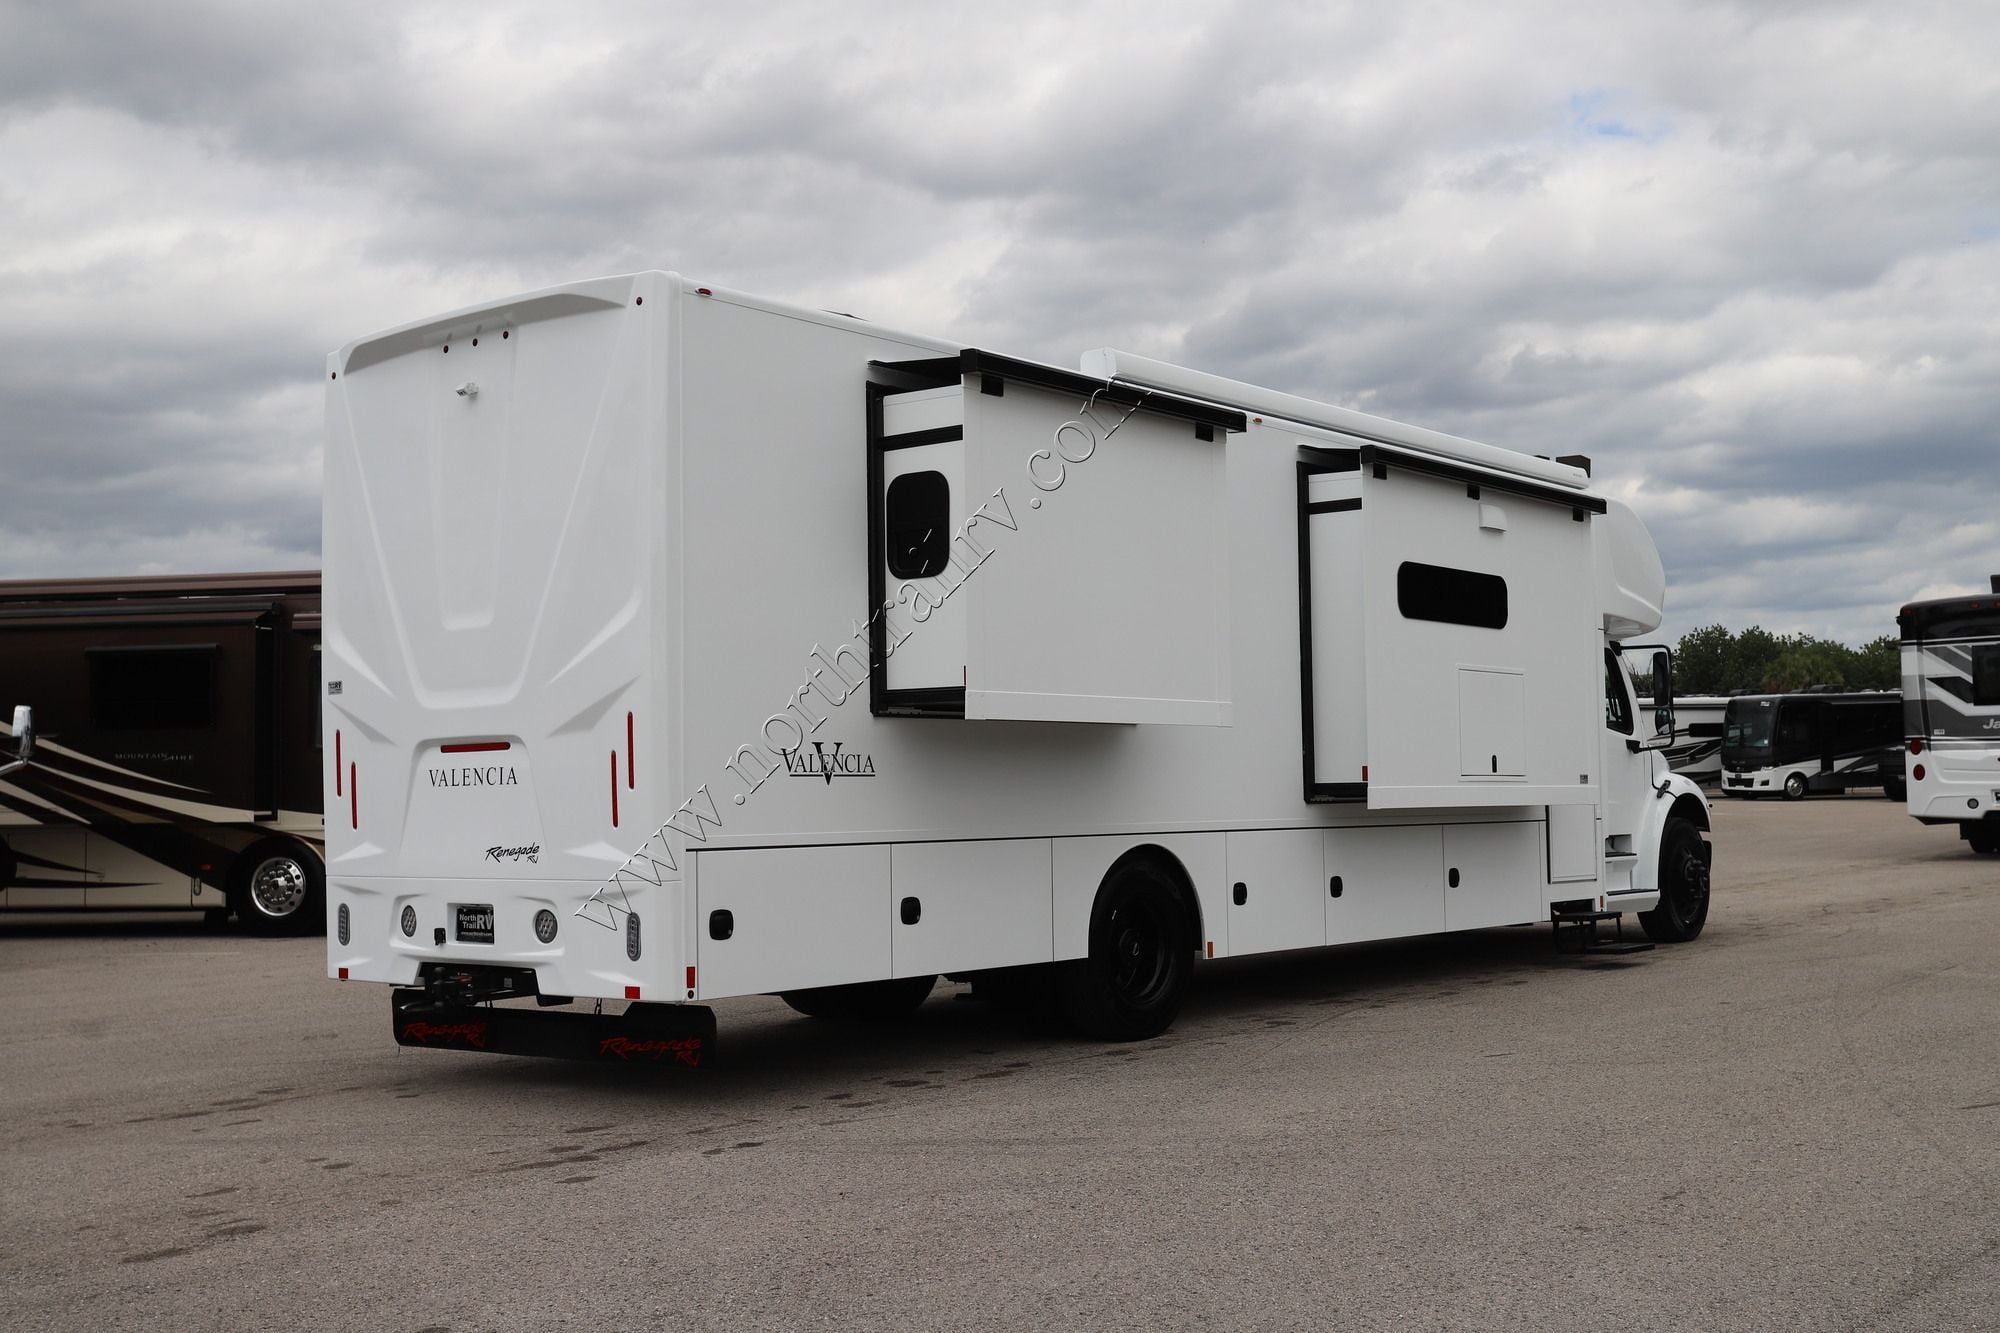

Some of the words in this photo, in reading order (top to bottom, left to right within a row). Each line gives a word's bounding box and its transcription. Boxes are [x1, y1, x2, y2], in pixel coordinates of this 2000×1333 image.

[780, 743, 875, 780] VALENCIA
[428, 766, 518, 787] VALENCIA
[485, 841, 540, 863] Renegade
[459, 913, 477, 921] North
[476, 914, 494, 930] RV
[462, 921, 477, 929] Trail
[600, 1035, 703, 1060] Renegade
